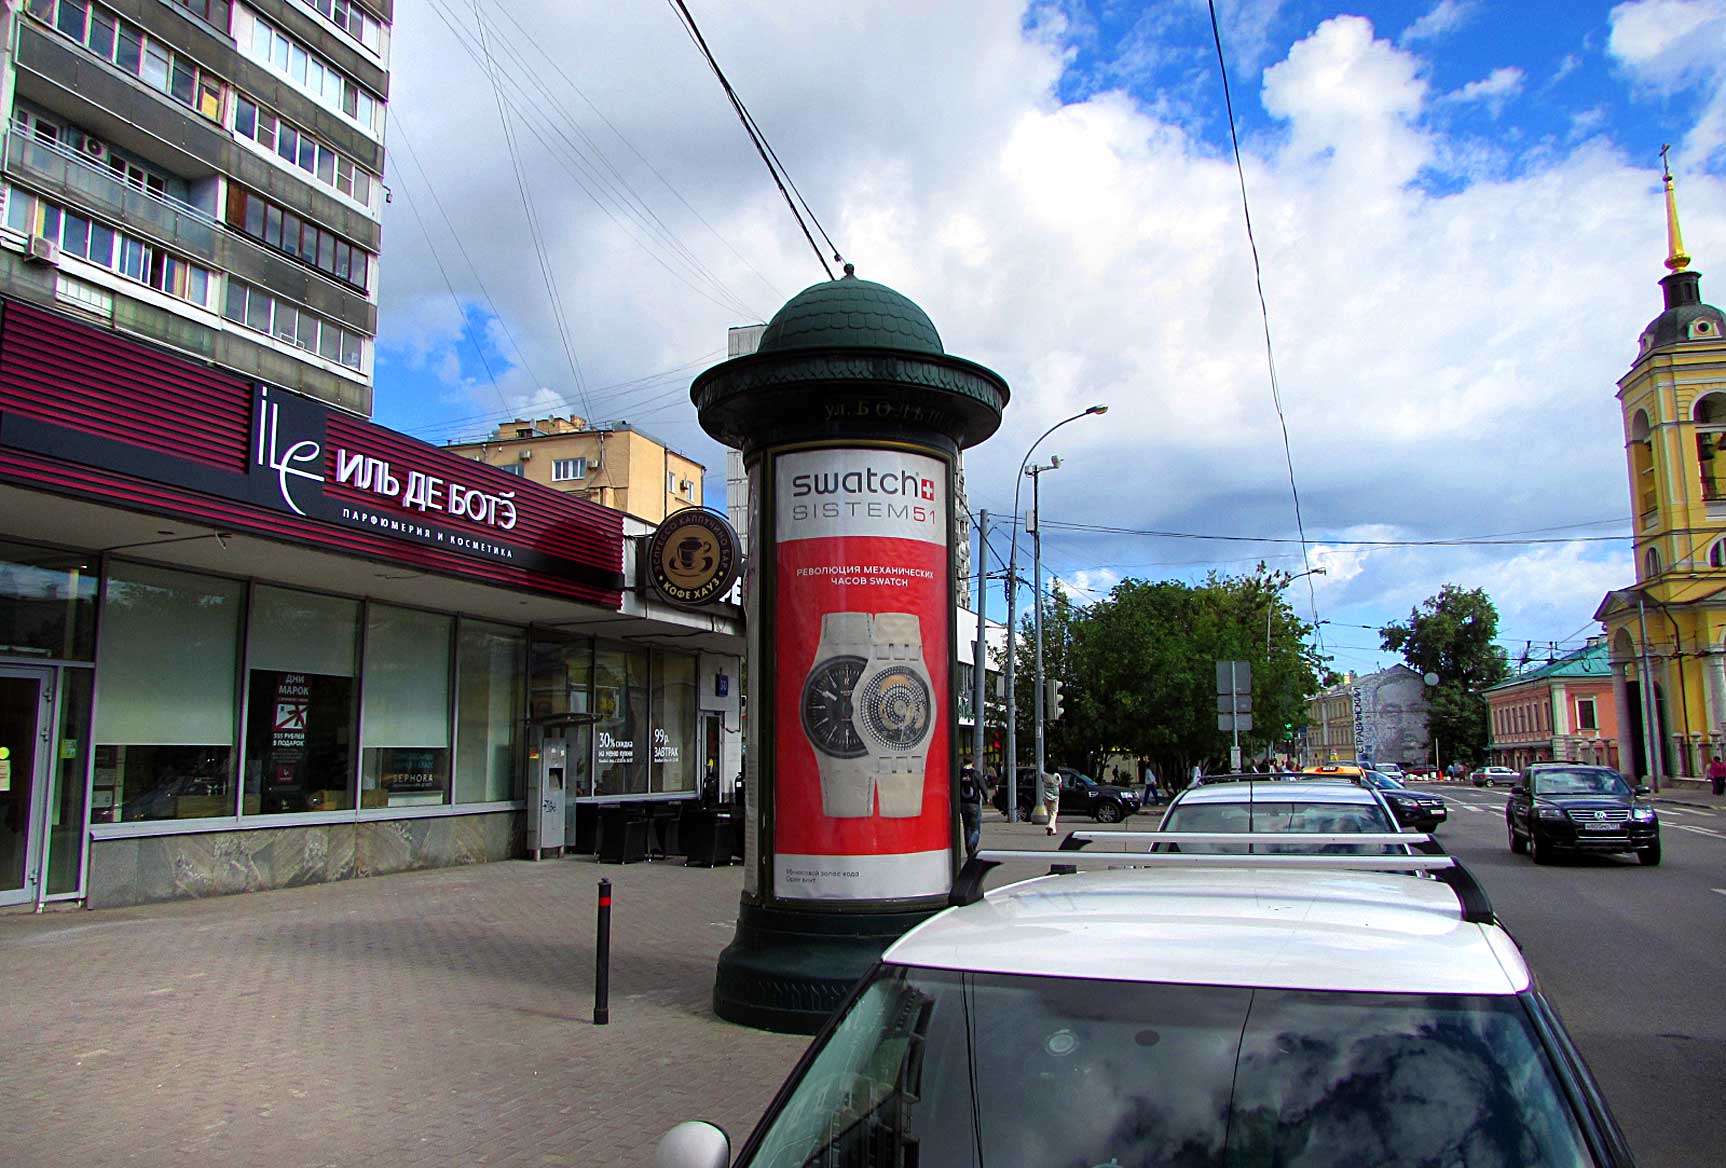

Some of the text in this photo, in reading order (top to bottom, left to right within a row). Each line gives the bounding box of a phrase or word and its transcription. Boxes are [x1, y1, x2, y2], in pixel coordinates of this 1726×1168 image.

[336, 449, 400, 496] ИЛЬ
[402, 471, 443, 512] ДЕ
[793, 467, 918, 497] swatch
[793, 502, 935, 525] SISTEM51
[343, 508, 512, 558] ПАРФЮМЕРИЯ И КОСМЕТИКА
[797, 565, 934, 579] РЕВОЛЮЦИЯ МЕХАНИЧЕСКИХ
[663, 578, 720, 599] КОФЕ ХАУЗ
[831, 577, 908, 587] ЧАСОВ SWATCH
[286, 675, 304, 683] ДНИ
[279, 686, 309, 695] МАРОК
[654, 747, 679, 757] ЗАВТРАК
[392, 774, 433, 783] SEPHORA
